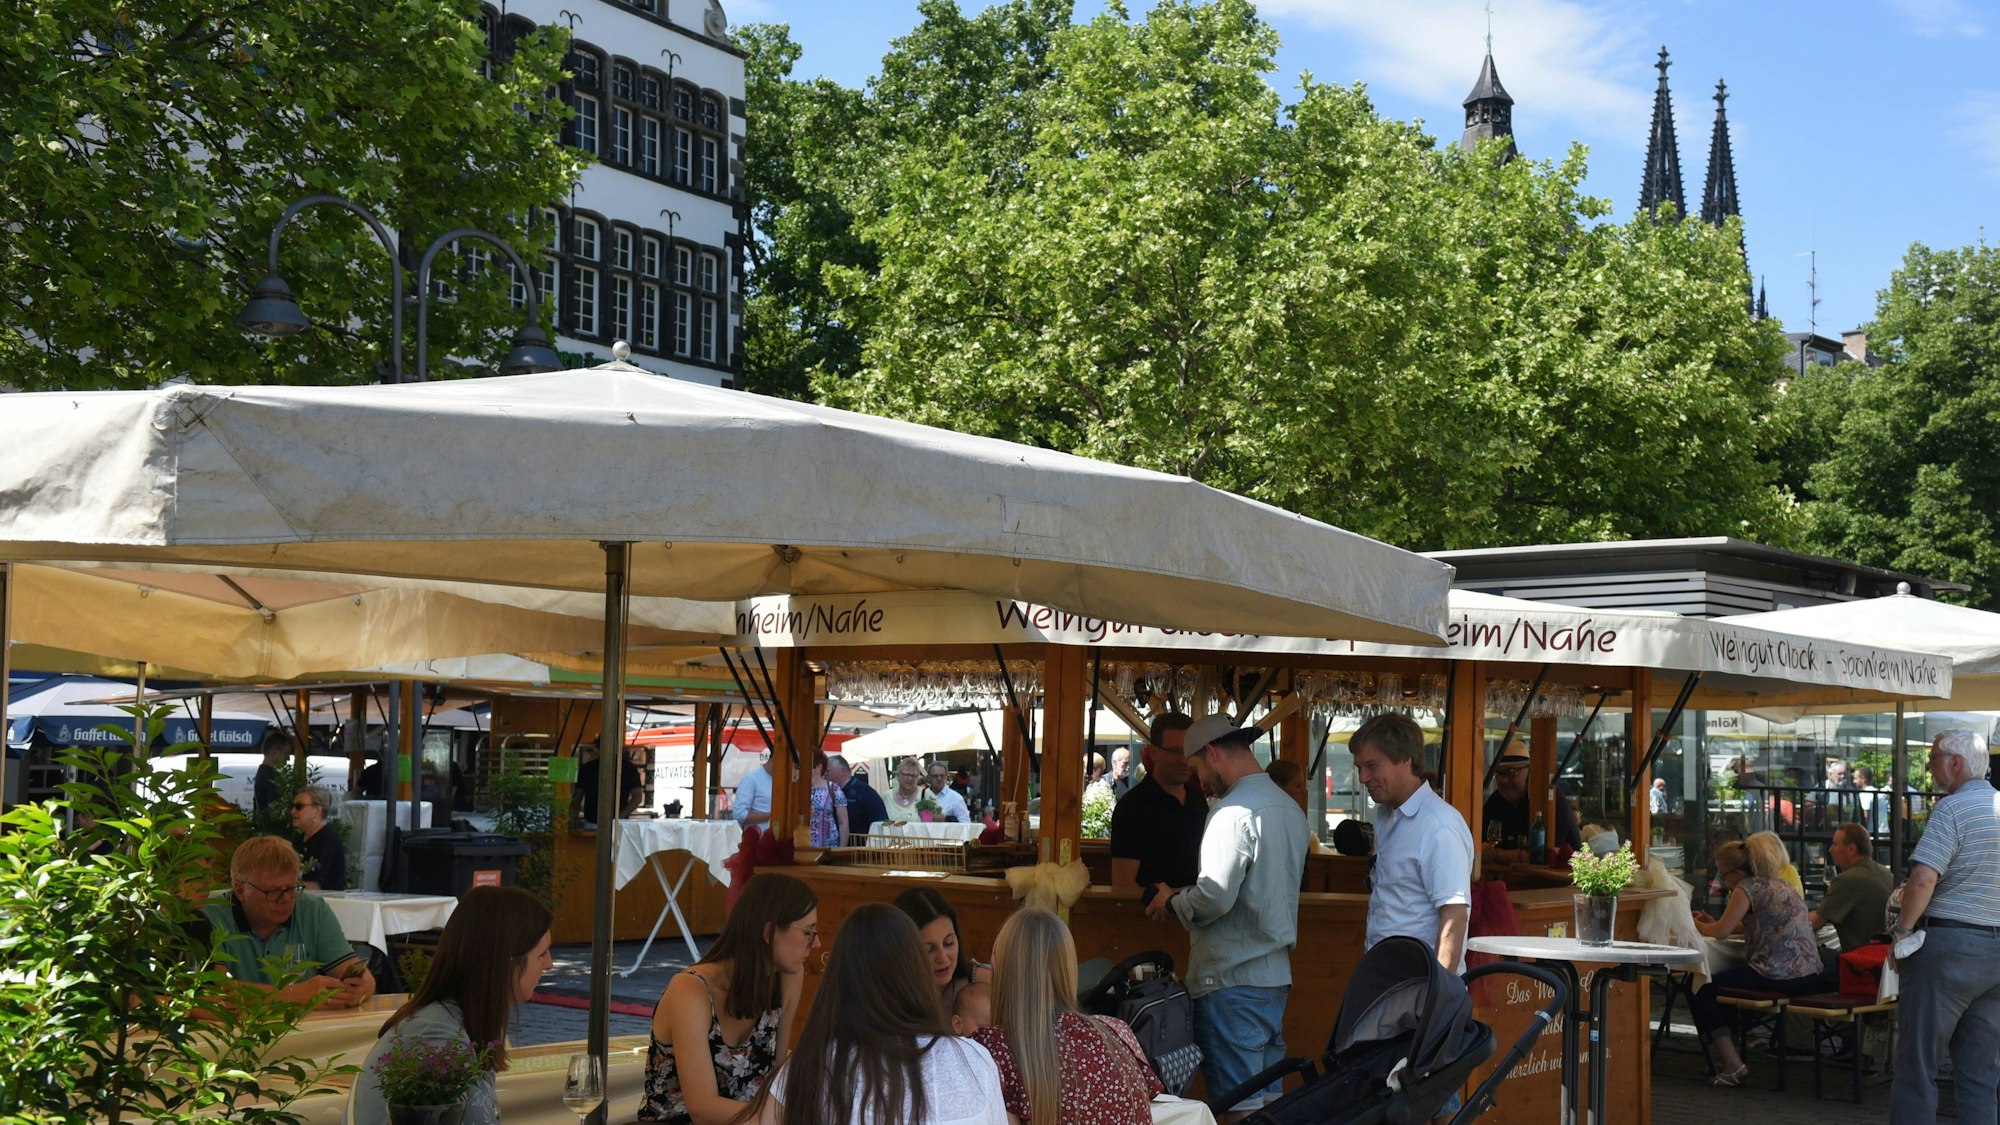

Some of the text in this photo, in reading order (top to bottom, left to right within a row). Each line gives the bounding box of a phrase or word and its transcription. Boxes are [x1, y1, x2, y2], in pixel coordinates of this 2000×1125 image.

[1709, 630, 1775, 673] Weingut
[73, 727, 107, 742] Gaffel
[219, 729, 252, 744] Kölsch
[1507, 978, 1532, 1004] Das
